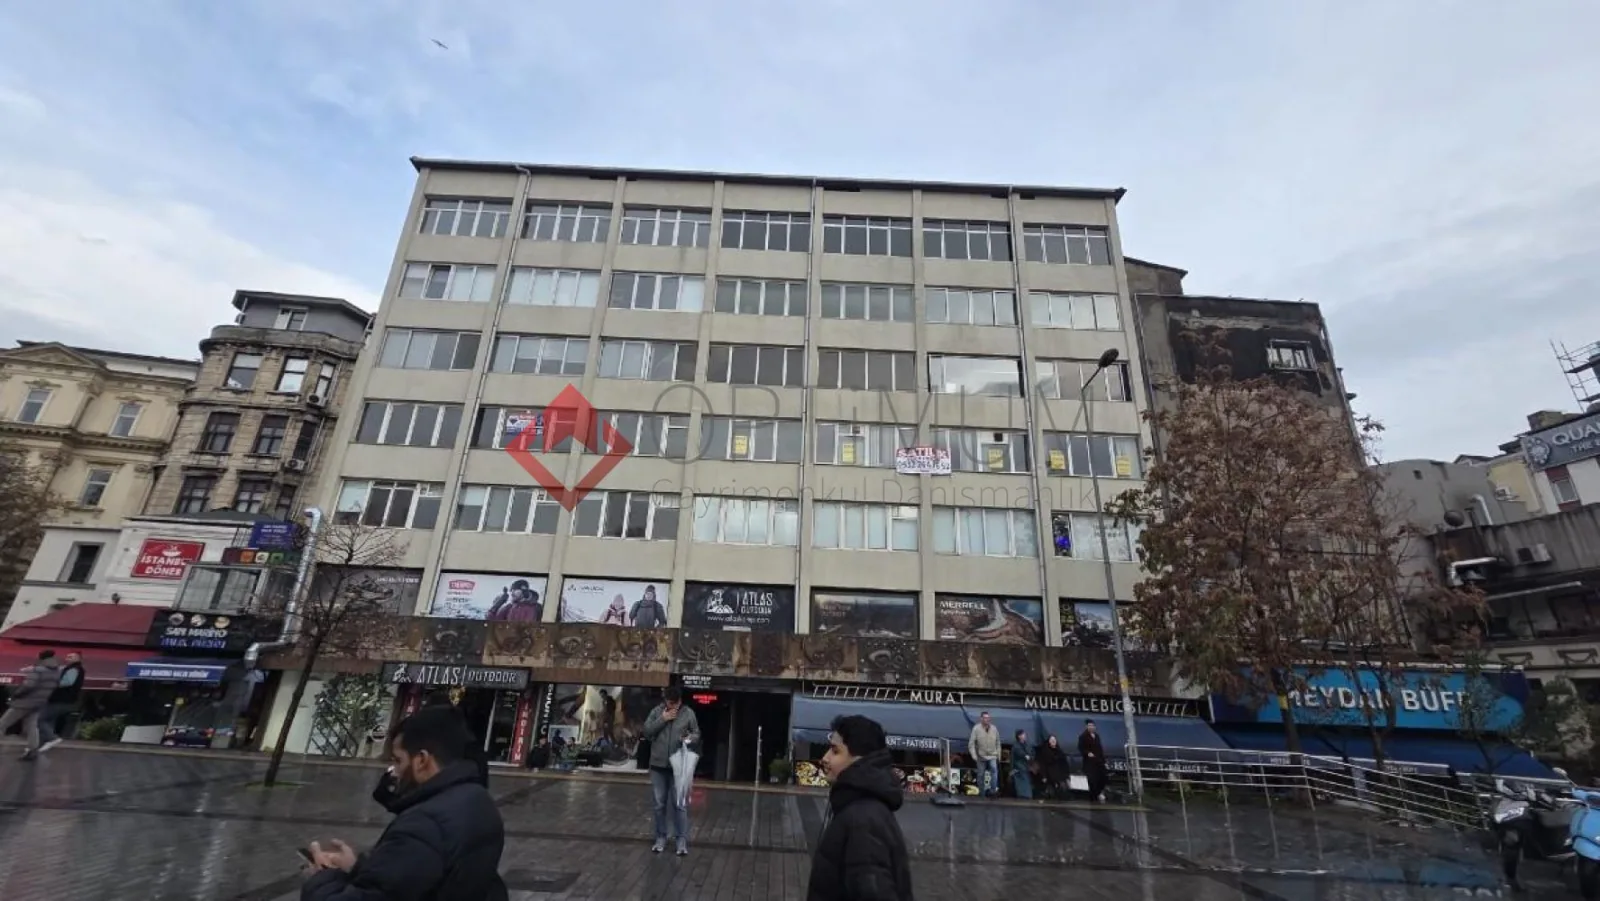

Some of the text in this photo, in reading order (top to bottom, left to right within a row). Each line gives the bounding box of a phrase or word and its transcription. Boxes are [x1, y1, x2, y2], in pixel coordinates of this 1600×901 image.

[1552, 422, 1600, 446] QUA
[144, 564, 183, 577] DÖNER
[742, 591, 773, 606] ATLAS
[940, 600, 987, 610] MERRELL
[416, 665, 517, 685] ATLAS OUTDOOR
[910, 690, 1142, 714] MURAT MUHALLEBICSI
